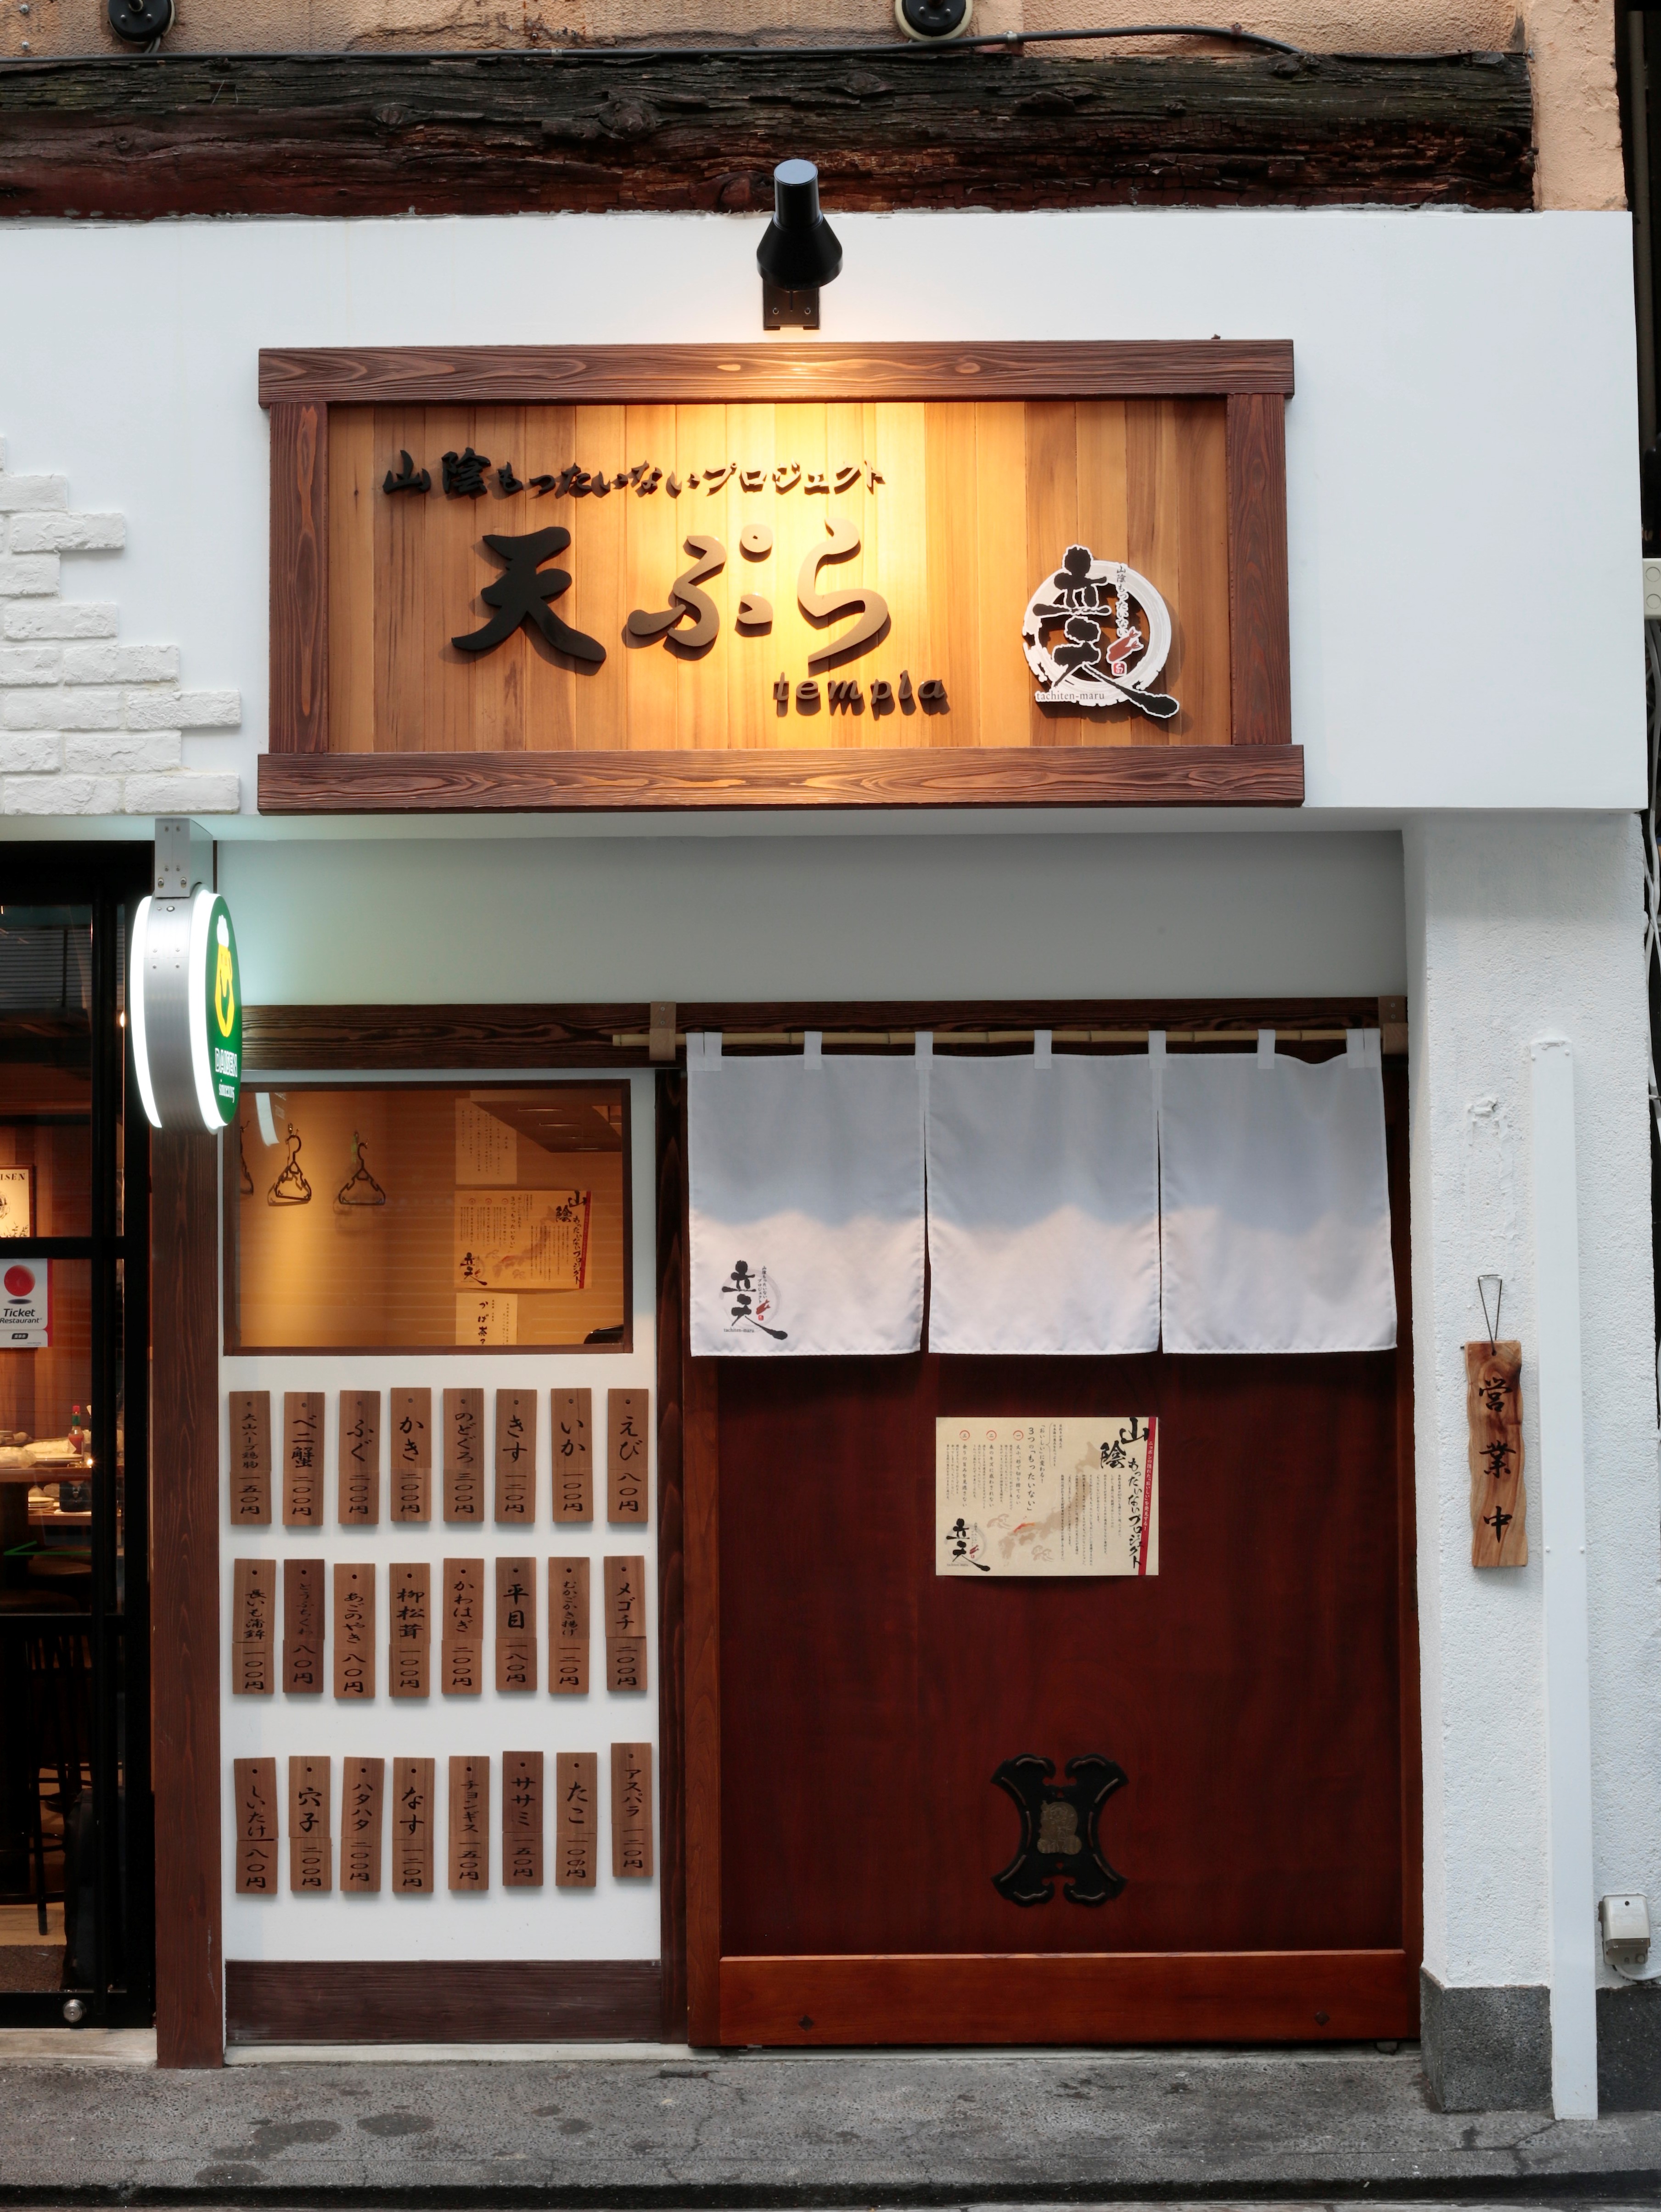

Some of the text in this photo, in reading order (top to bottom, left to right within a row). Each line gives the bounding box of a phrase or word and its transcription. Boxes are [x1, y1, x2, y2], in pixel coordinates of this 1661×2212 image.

[382, 446, 885, 497] 山陰もったいないプロジェクト
[450, 518, 889, 666] 天ぷら
[773, 671, 946, 707] templa
[1037, 690, 1105, 700] tachiten-maru
[215, 1047, 237, 1077] DAISEN
[4, 1308, 35, 1317] Ticket
[347, 1419, 374, 1462] ふぐ
[399, 1416, 424, 1461] かき
[455, 1413, 476, 1463] のどぐろ
[503, 1414, 527, 1463] きす
[561, 1420, 585, 1457] いか
[619, 1416, 643, 1460] えび
[1479, 1377, 1516, 1543] 営業中
[342, 1593, 365, 1644] あごのやき
[396, 1588, 425, 1639] 柳松茸
[454, 1581, 474, 1632] かわはぎ
[503, 1583, 529, 1629] 平目
[616, 1583, 635, 1630] メゴチ
[247, 1785, 265, 1837] しいたけ
[299, 1787, 322, 1833] 穴子
[352, 1784, 373, 1831] ハタハタ
[400, 1787, 424, 1835] なす
[511, 1777, 536, 1826] ササミ
[567, 1781, 588, 1824] たこ
[623, 1769, 643, 1817] アスパラ
